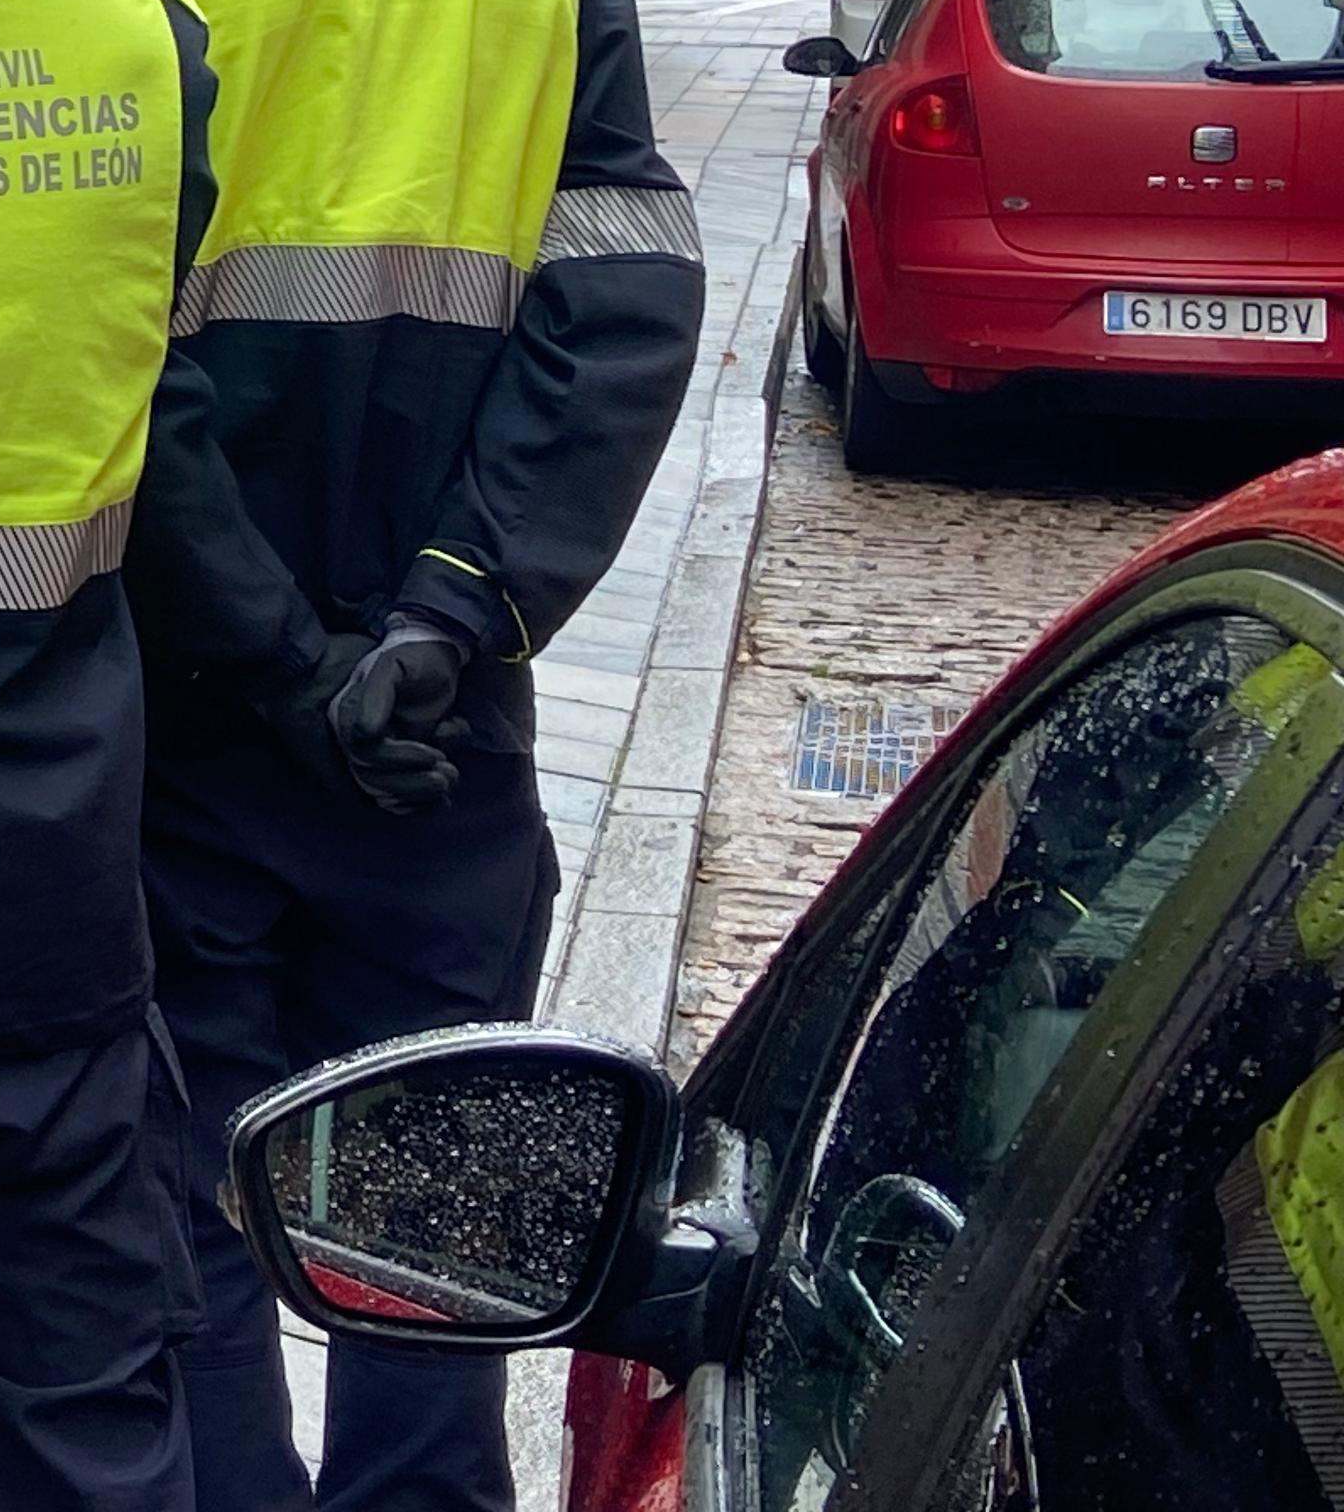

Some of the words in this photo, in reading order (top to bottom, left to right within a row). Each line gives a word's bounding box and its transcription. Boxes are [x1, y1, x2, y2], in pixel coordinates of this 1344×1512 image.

[20, 152, 64, 194] DE
[73, 138, 143, 190] LEÓN
[1130, 297, 1228, 331] 6169
[1242, 302, 1315, 334] DBV
